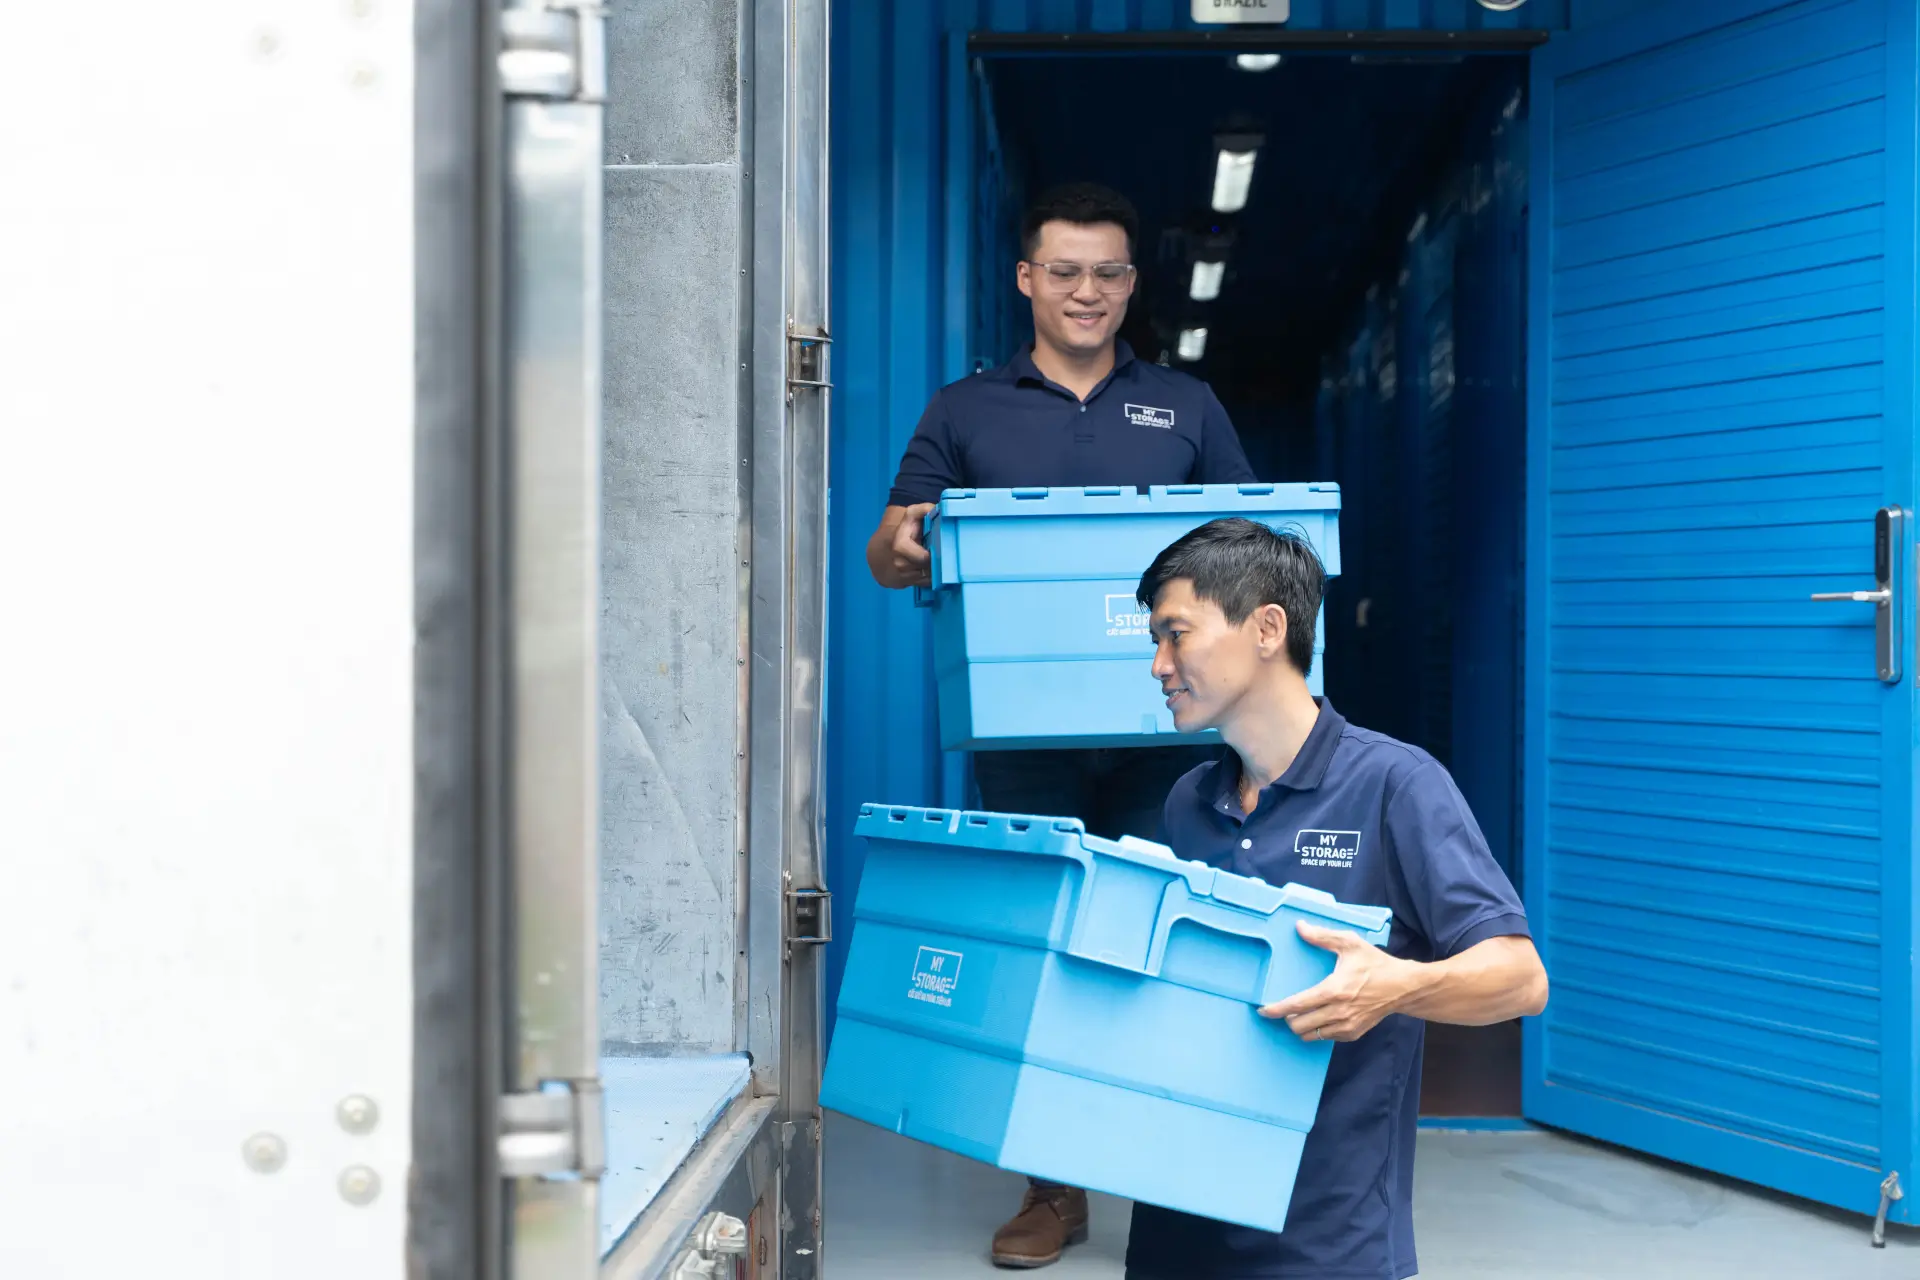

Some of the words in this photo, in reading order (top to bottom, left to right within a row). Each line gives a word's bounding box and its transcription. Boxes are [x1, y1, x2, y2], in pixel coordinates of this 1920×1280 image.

[1131, 413, 1170, 426] STORAGE
[1143, 409, 1156, 417] MY
[1115, 614, 1151, 627] STOR
[1320, 834, 1337, 846] MY
[1301, 846, 1354, 860] STORAGE
[1301, 858, 1318, 866] SPACE
[1319, 859, 1327, 867] UP
[1327, 860, 1342, 868] YOUR
[1342, 860, 1353, 868] LIFE
[930, 955, 945, 973] MY
[915, 971, 953, 995] STORAGE
